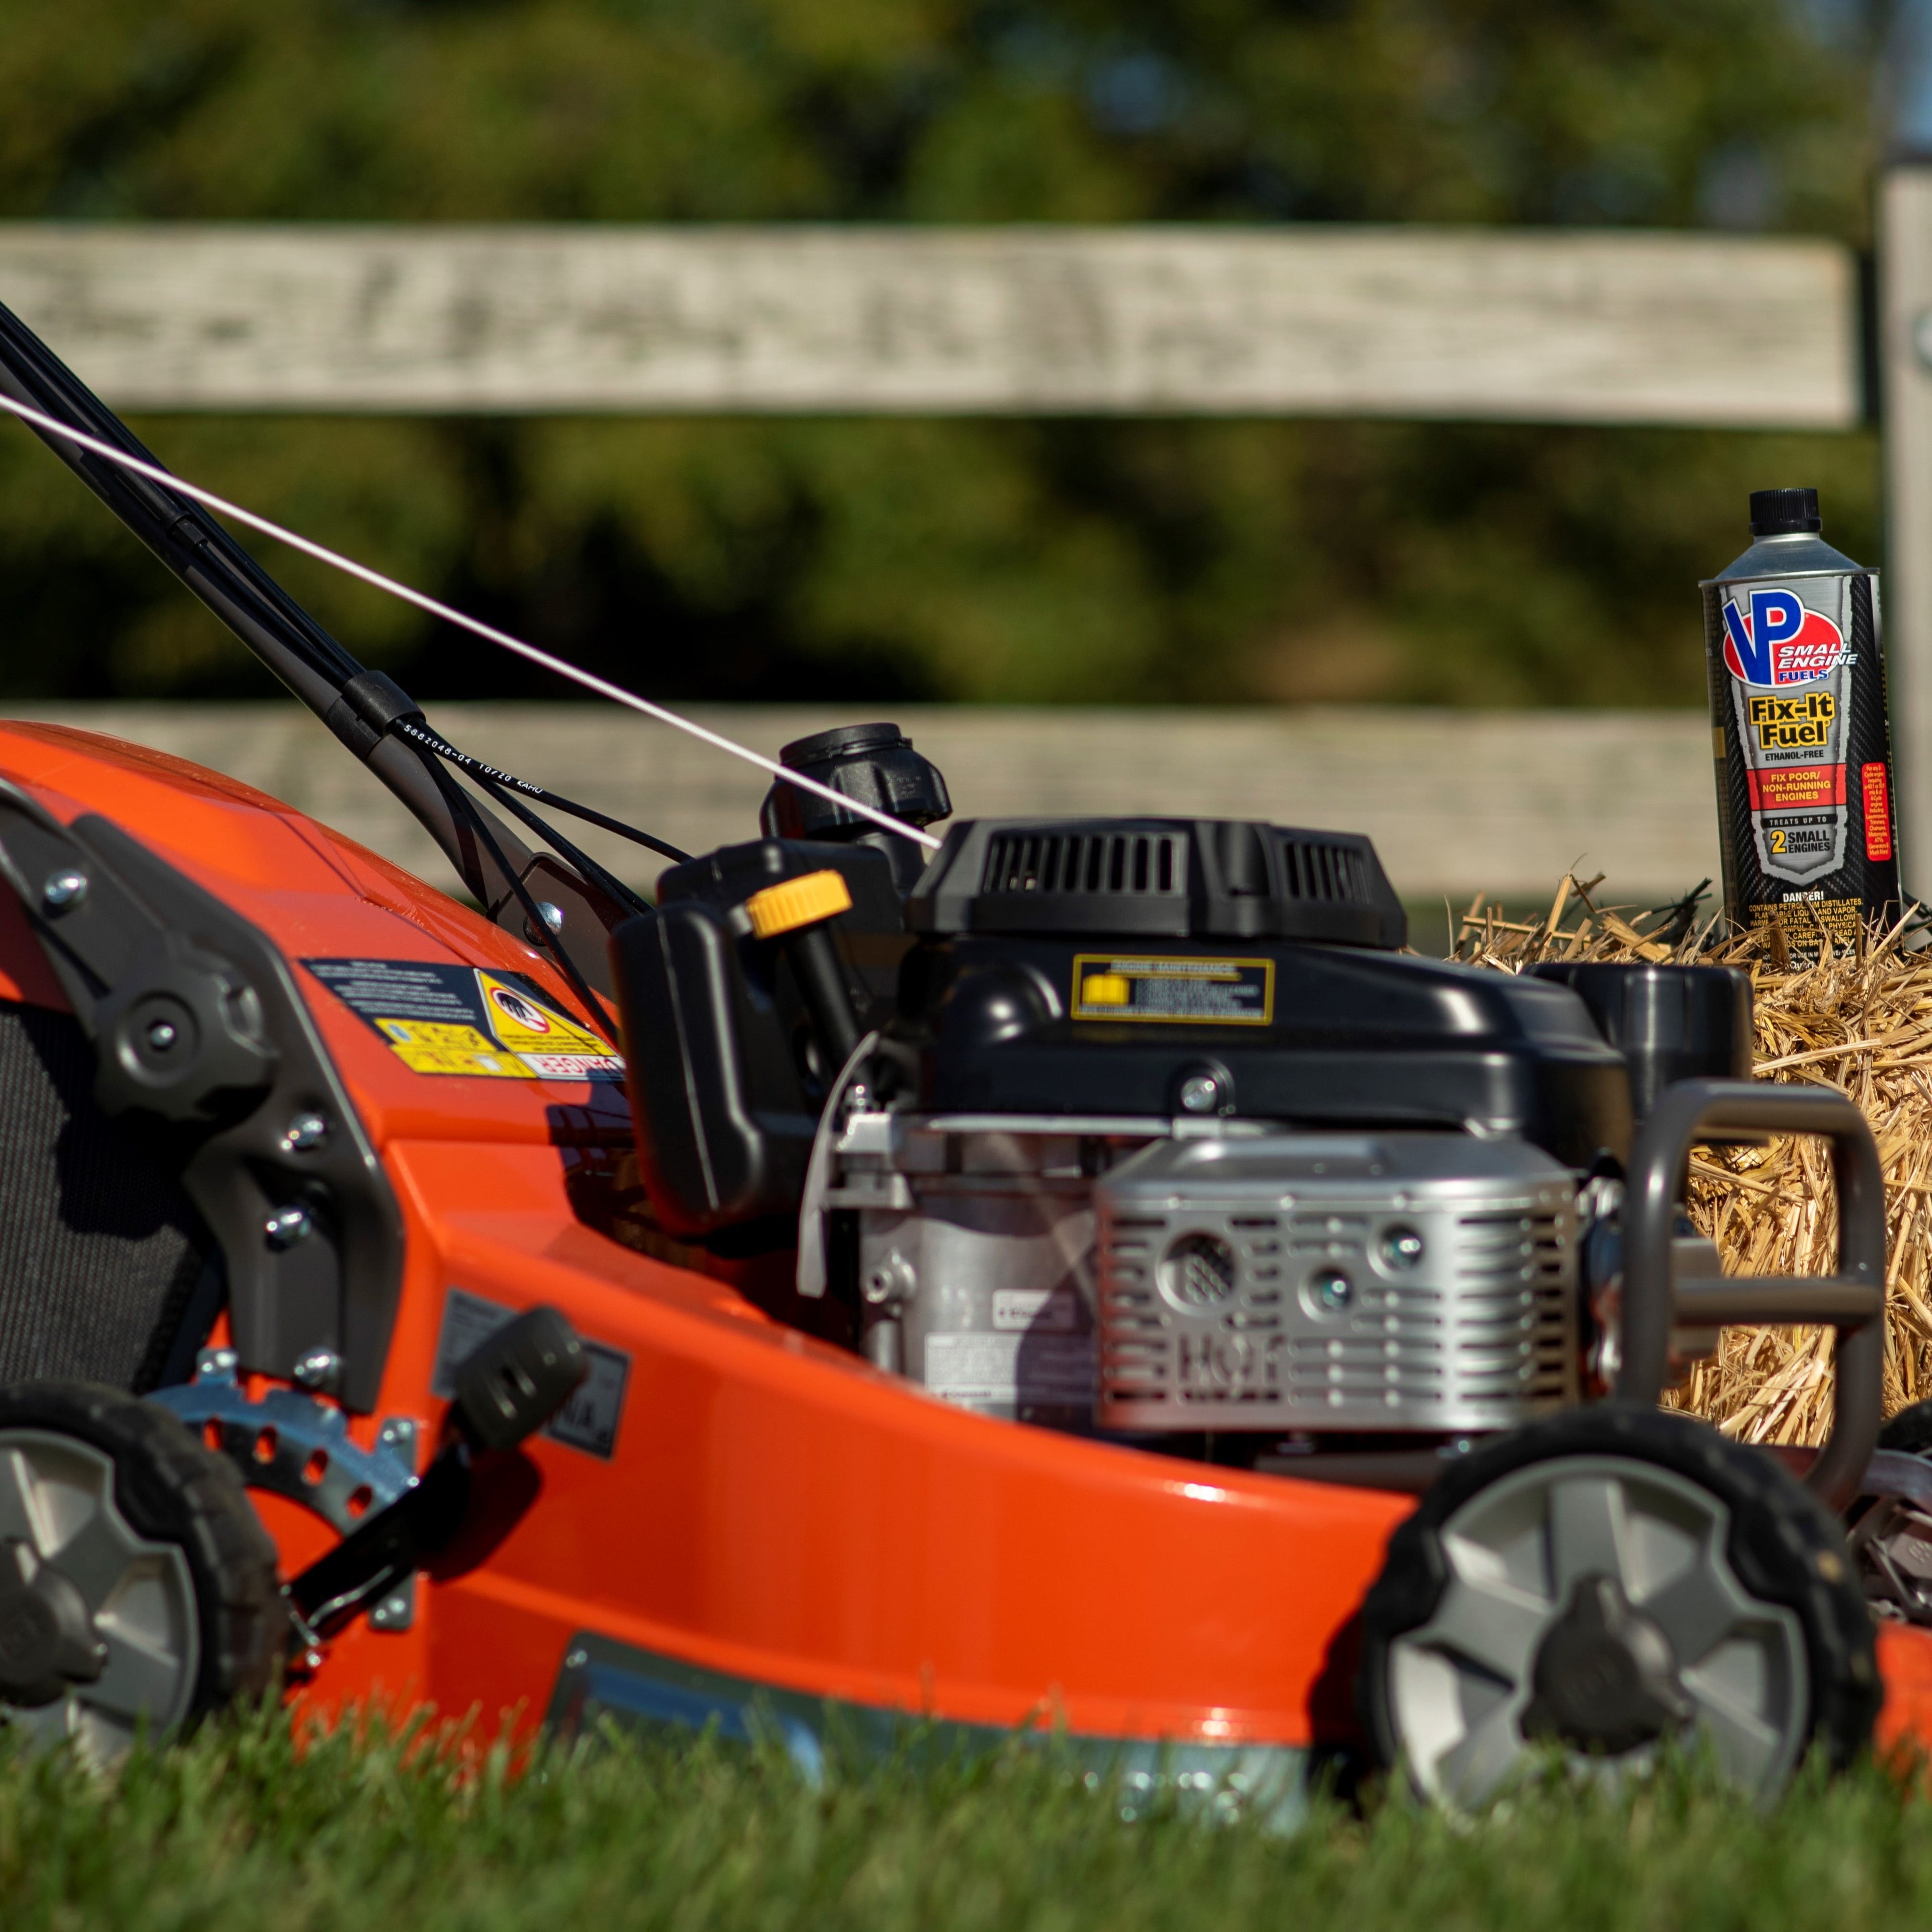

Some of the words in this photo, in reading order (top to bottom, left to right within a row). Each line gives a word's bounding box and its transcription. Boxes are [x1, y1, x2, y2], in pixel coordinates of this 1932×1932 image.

[1722, 589, 1805, 687] VP
[1778, 643, 1851, 658] SMALL
[1778, 654, 1858, 669] ENGINE
[1779, 669, 1828, 682] FUELS
[1750, 693, 1834, 723] Fix-It
[1761, 721, 1826, 748] Fuel
[404, 725, 471, 765] 5882048-04
[479, 764, 512, 782] 10/20
[517, 780, 543, 794] KAHU
[1765, 750, 1824, 761] ETHANOL-FREE
[1771, 774, 1786, 782] FIX
[1789, 771, 1820, 780] POOR/
[1762, 780, 1831, 793] NON-RUNNING
[1776, 791, 1819, 802] ENGINES
[1769, 818, 1799, 826] TREATS
[1770, 830, 1787, 854] 2
[1788, 830, 1830, 844] SMALL
[1788, 842, 1830, 853] ENGINES
[1749, 904, 1778, 912] CONTAINS
[1822, 899, 1863, 908] DISTILLATES.
[1833, 906, 1857, 914] VAPOR.
